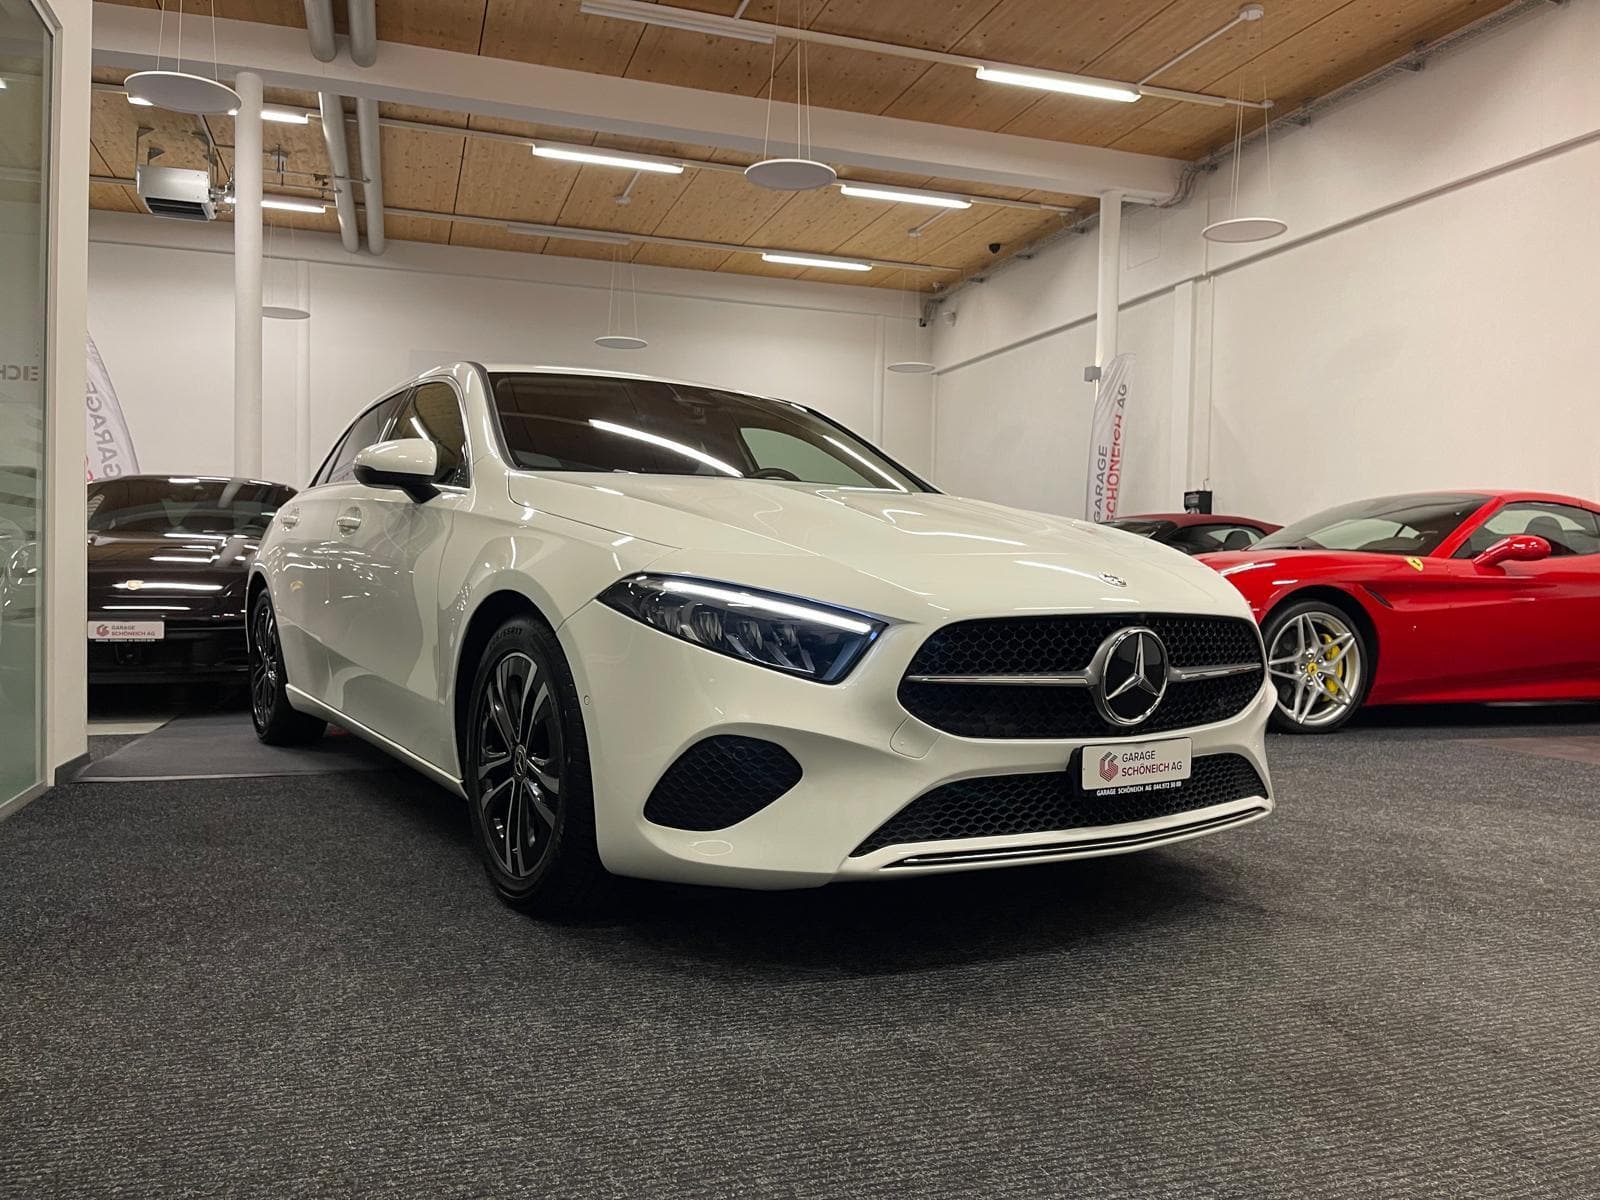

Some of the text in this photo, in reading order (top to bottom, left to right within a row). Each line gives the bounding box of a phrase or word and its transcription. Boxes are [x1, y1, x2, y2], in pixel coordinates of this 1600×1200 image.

[1116, 384, 1127, 409] AG
[1093, 444, 1108, 523] GARAGE
[1121, 750, 1156, 763] GARAGE
[1121, 761, 1183, 777] SCHÖNEICH AG
